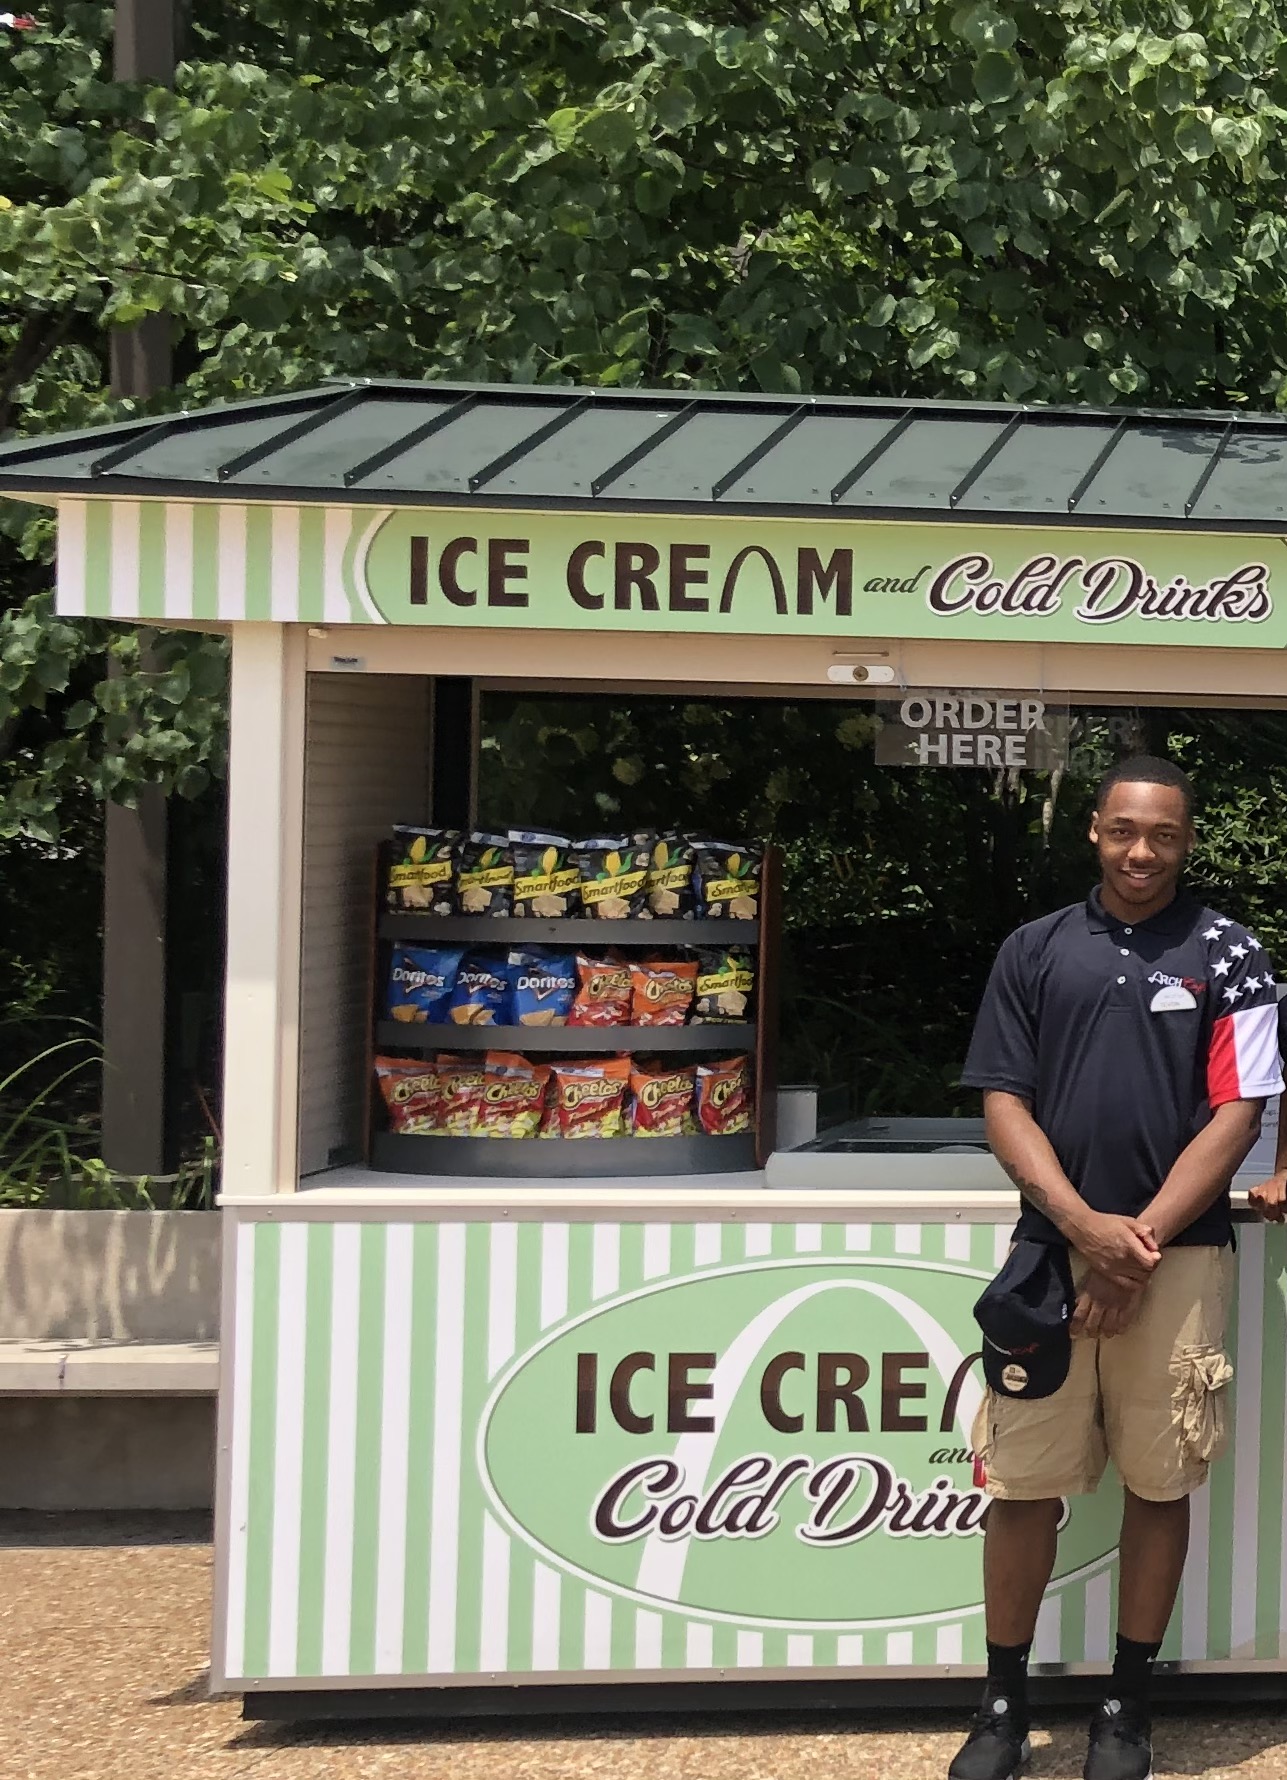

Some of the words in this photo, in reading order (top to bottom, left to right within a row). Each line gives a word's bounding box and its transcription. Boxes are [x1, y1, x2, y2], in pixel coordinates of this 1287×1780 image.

[410, 535, 530, 607] ICE
[566, 540, 853, 616] CREAM
[863, 565, 932, 594] and
[928, 553, 1085, 616] Cold
[1075, 556, 1273, 623] Drinks
[900, 697, 1046, 730] ORDER
[919, 734, 1027, 766] HERE
[393, 968, 445, 987] Doritos
[517, 976, 575, 990] Doritos
[563, 1079, 622, 1110] Cheetos
[574, 1351, 717, 1435] ICE
[929, 1445, 974, 1465] an
[592, 1453, 807, 1545] Cold
[796, 1456, 990, 1547] Drin
